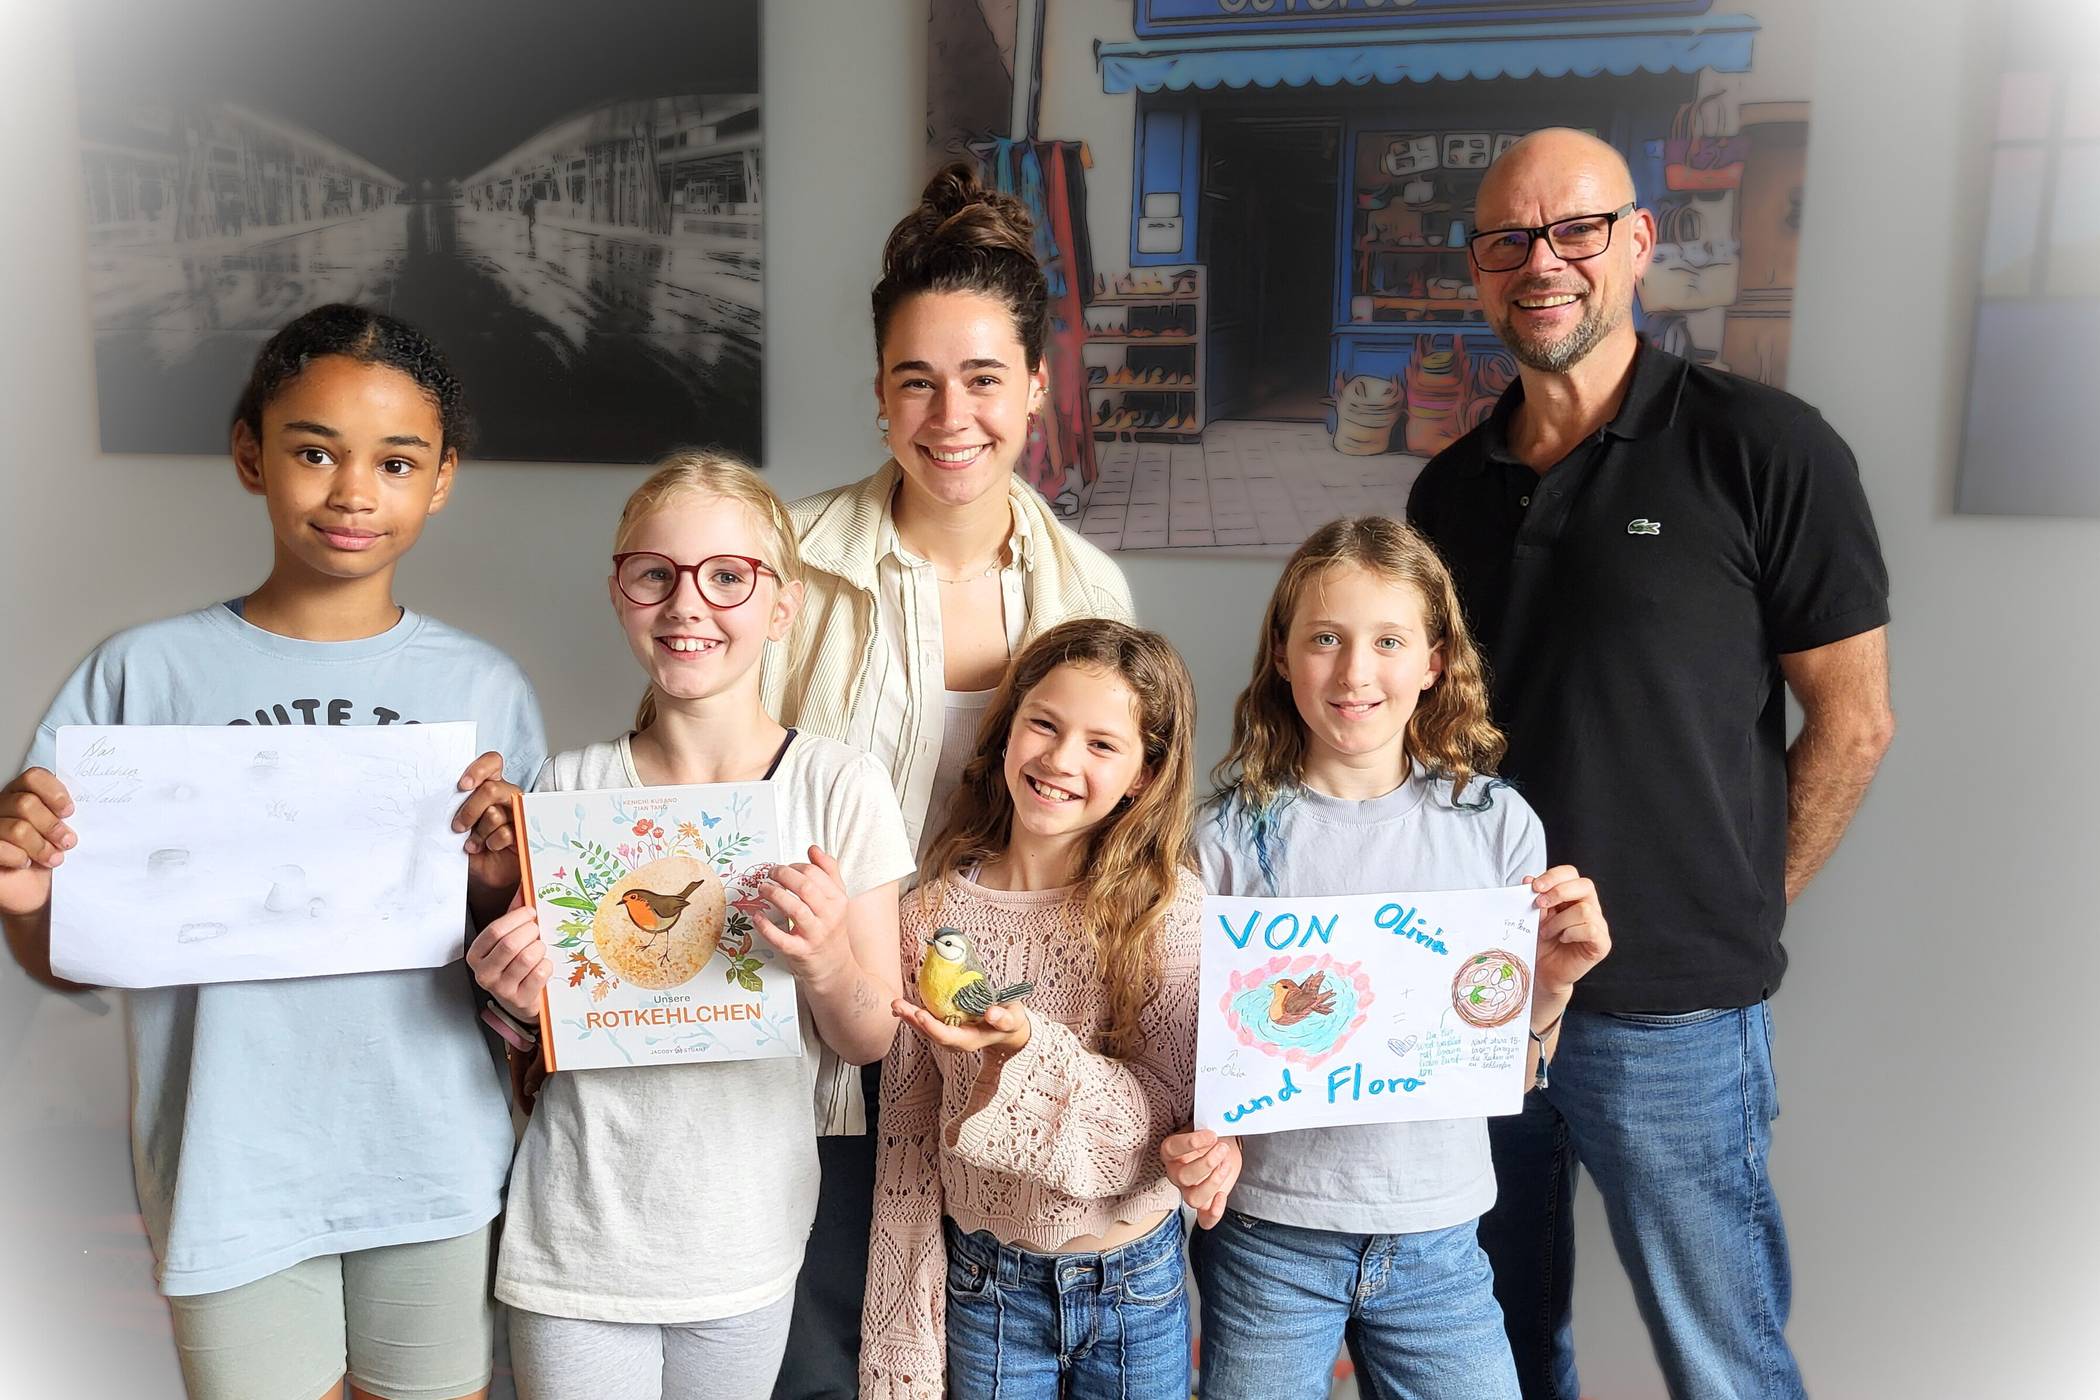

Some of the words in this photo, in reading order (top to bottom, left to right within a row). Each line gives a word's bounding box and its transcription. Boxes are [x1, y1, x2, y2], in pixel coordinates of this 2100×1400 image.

[1217, 910, 1339, 950] VON
[653, 994, 691, 1004] Unsere
[586, 1003, 761, 1029] ROTKEHLCHEN
[1223, 1068, 1302, 1123] und
[1327, 1062, 1426, 1104] Flora
